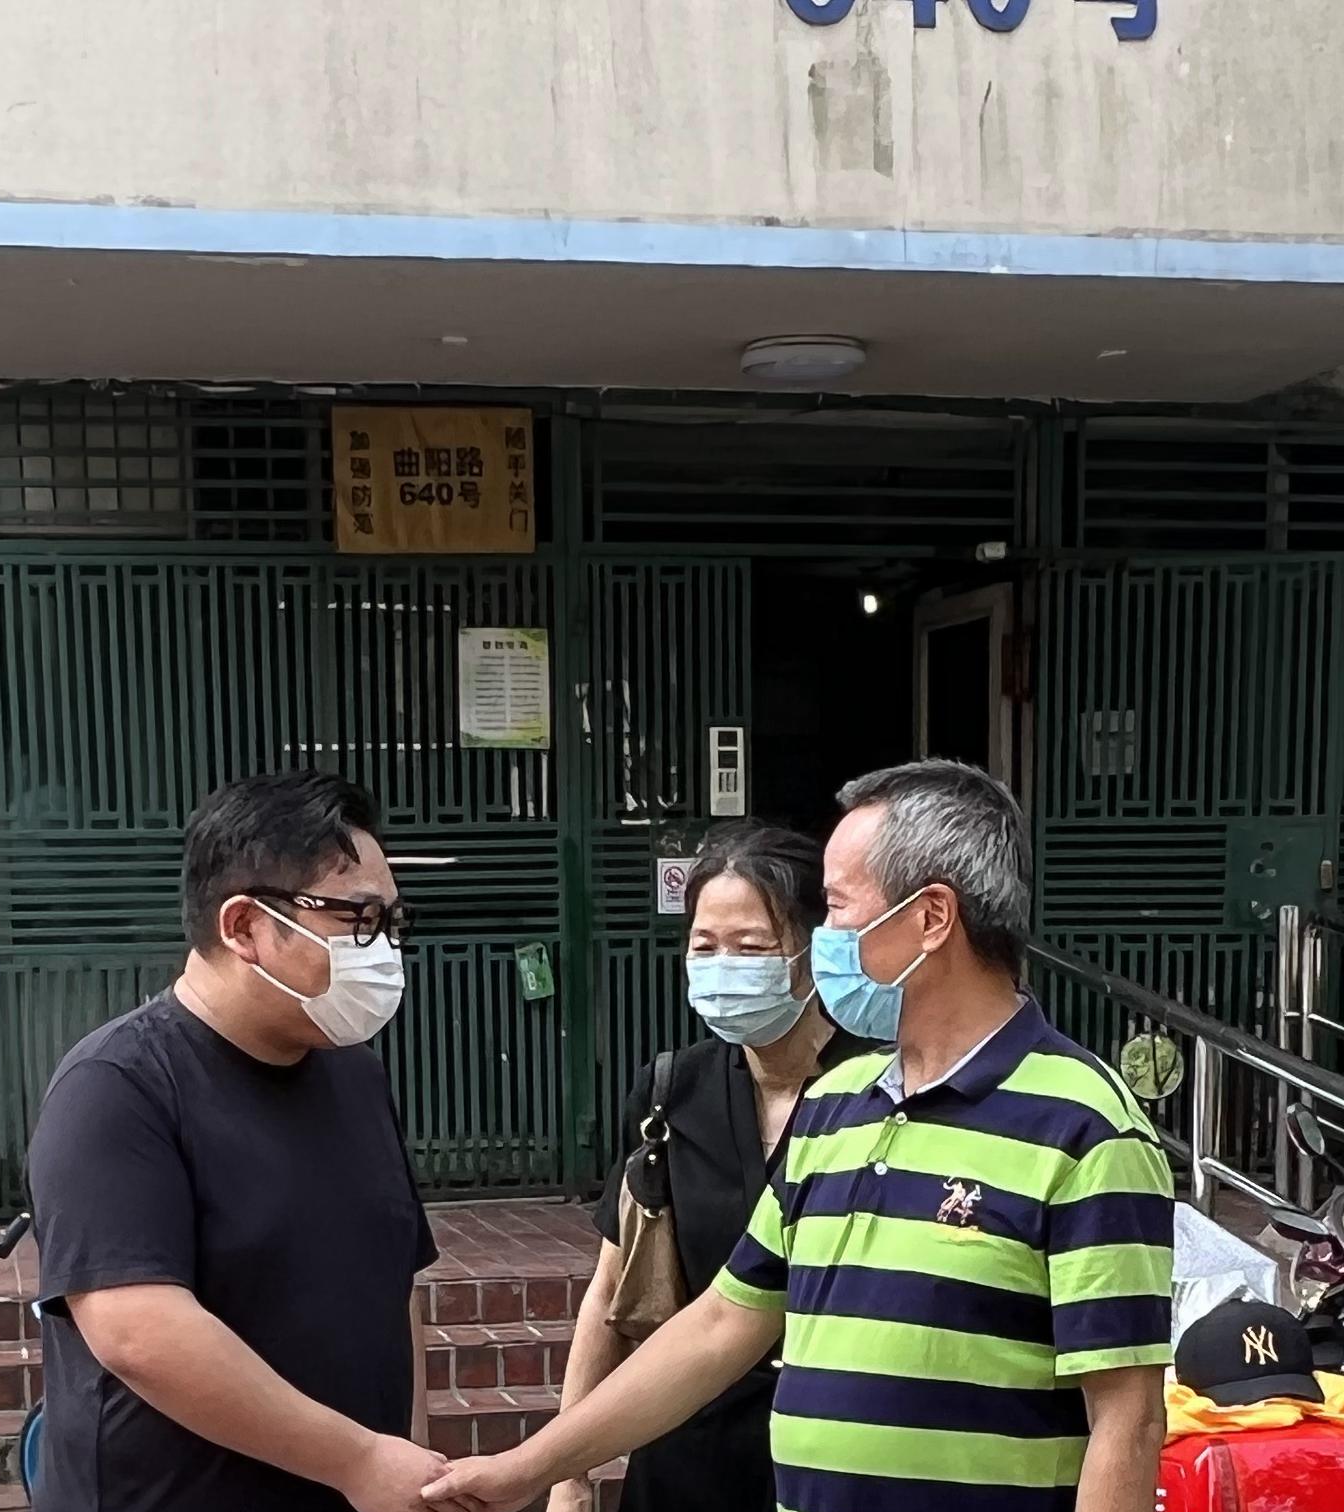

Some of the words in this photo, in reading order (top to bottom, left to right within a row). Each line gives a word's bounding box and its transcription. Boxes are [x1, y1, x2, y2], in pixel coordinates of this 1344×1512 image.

[393, 447, 483, 477] 曲阳路
[399, 481, 481, 509] 640号
[1242, 1324, 1279, 1365] NY
